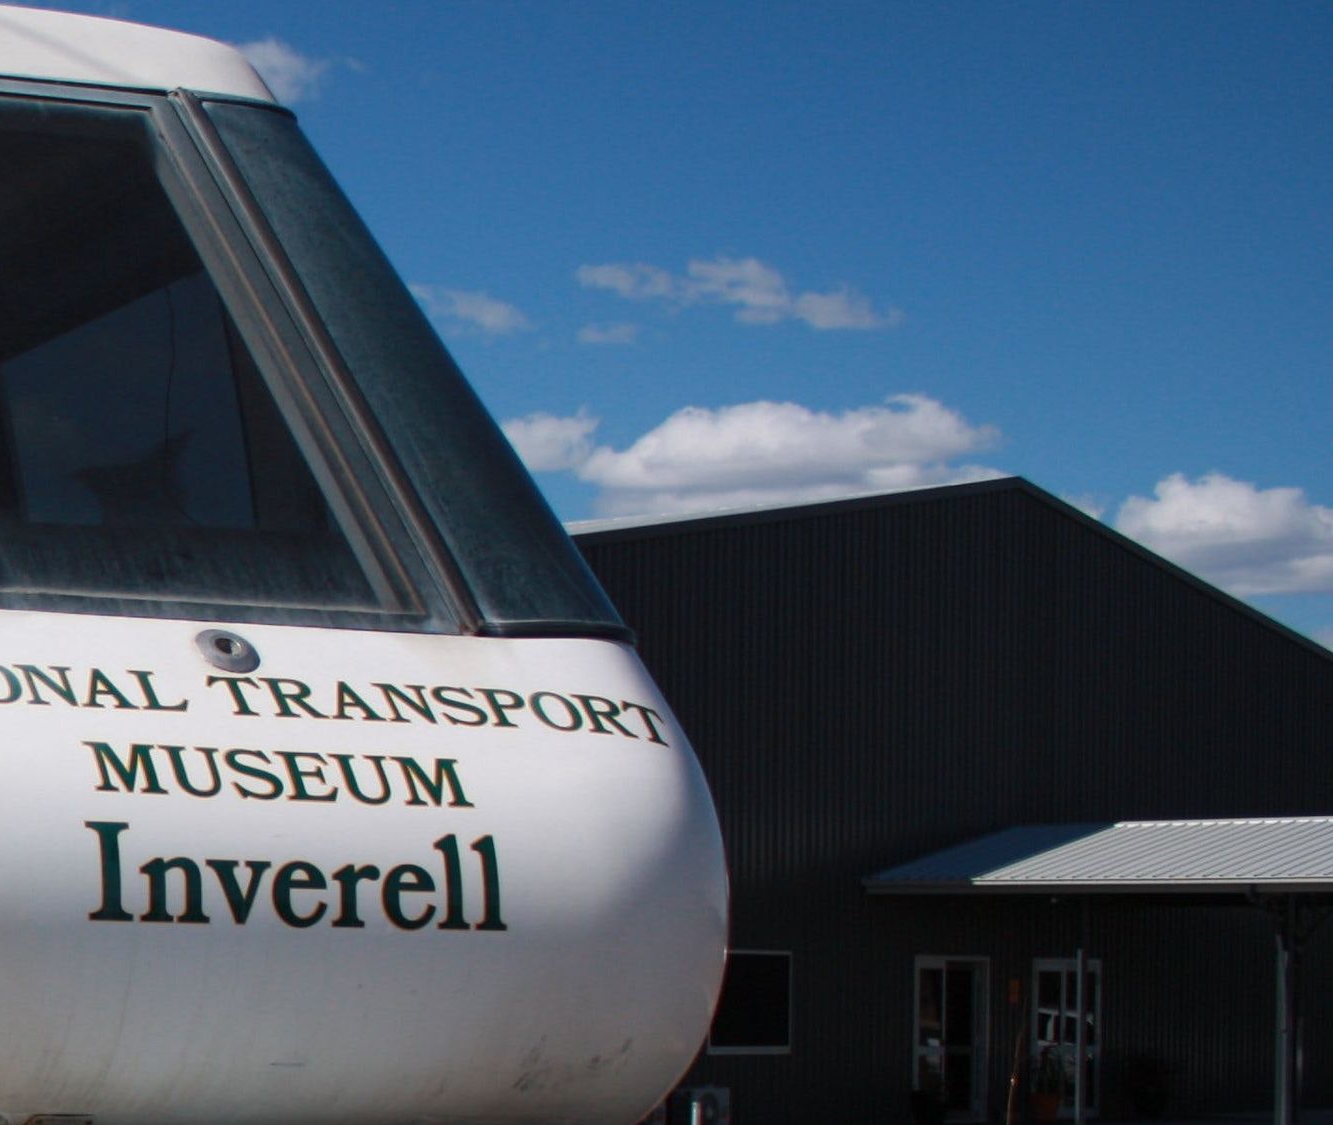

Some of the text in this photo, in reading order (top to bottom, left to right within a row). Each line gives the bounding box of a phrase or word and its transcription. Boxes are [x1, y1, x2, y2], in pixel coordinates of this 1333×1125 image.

[207, 676, 668, 747] TRANSPORT
[81, 741, 474, 808] MUSEUM
[84, 820, 508, 931] Inverell
